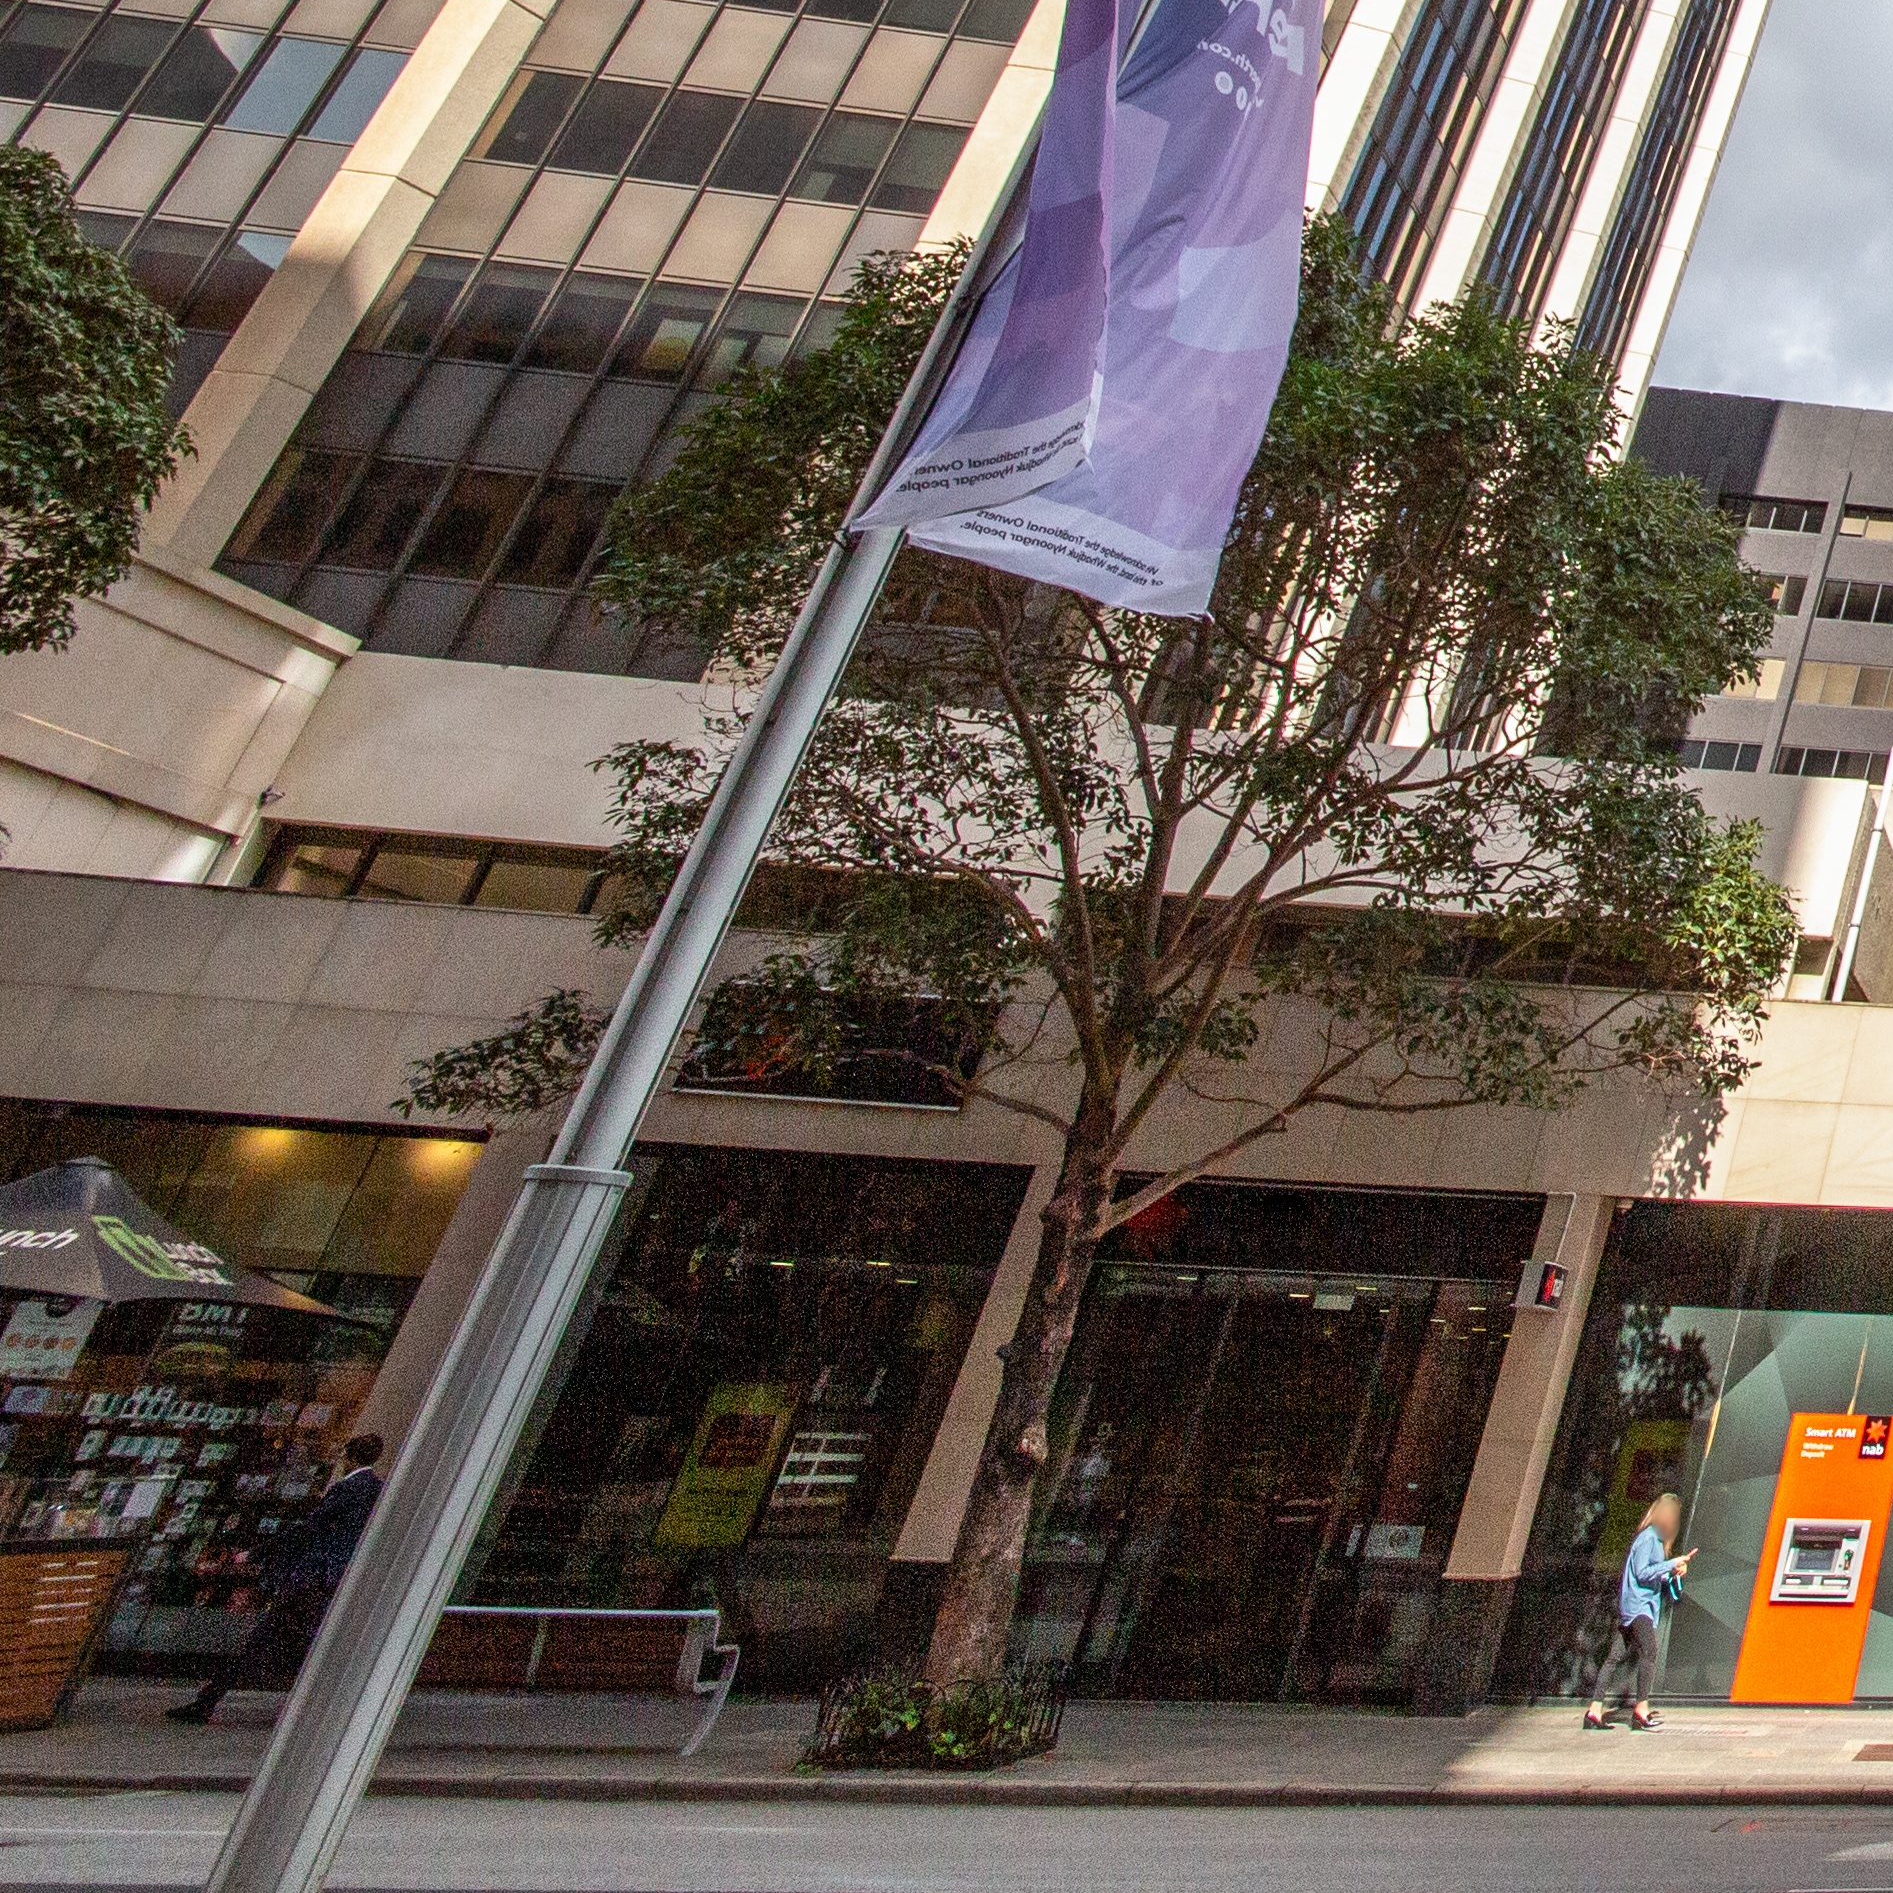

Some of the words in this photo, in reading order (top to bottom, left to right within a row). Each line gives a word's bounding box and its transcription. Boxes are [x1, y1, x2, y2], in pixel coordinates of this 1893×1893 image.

[1805, 1426, 1833, 1438] Smart
[1834, 1427, 1857, 1438] ATM
[1861, 1443, 1885, 1456] nab
